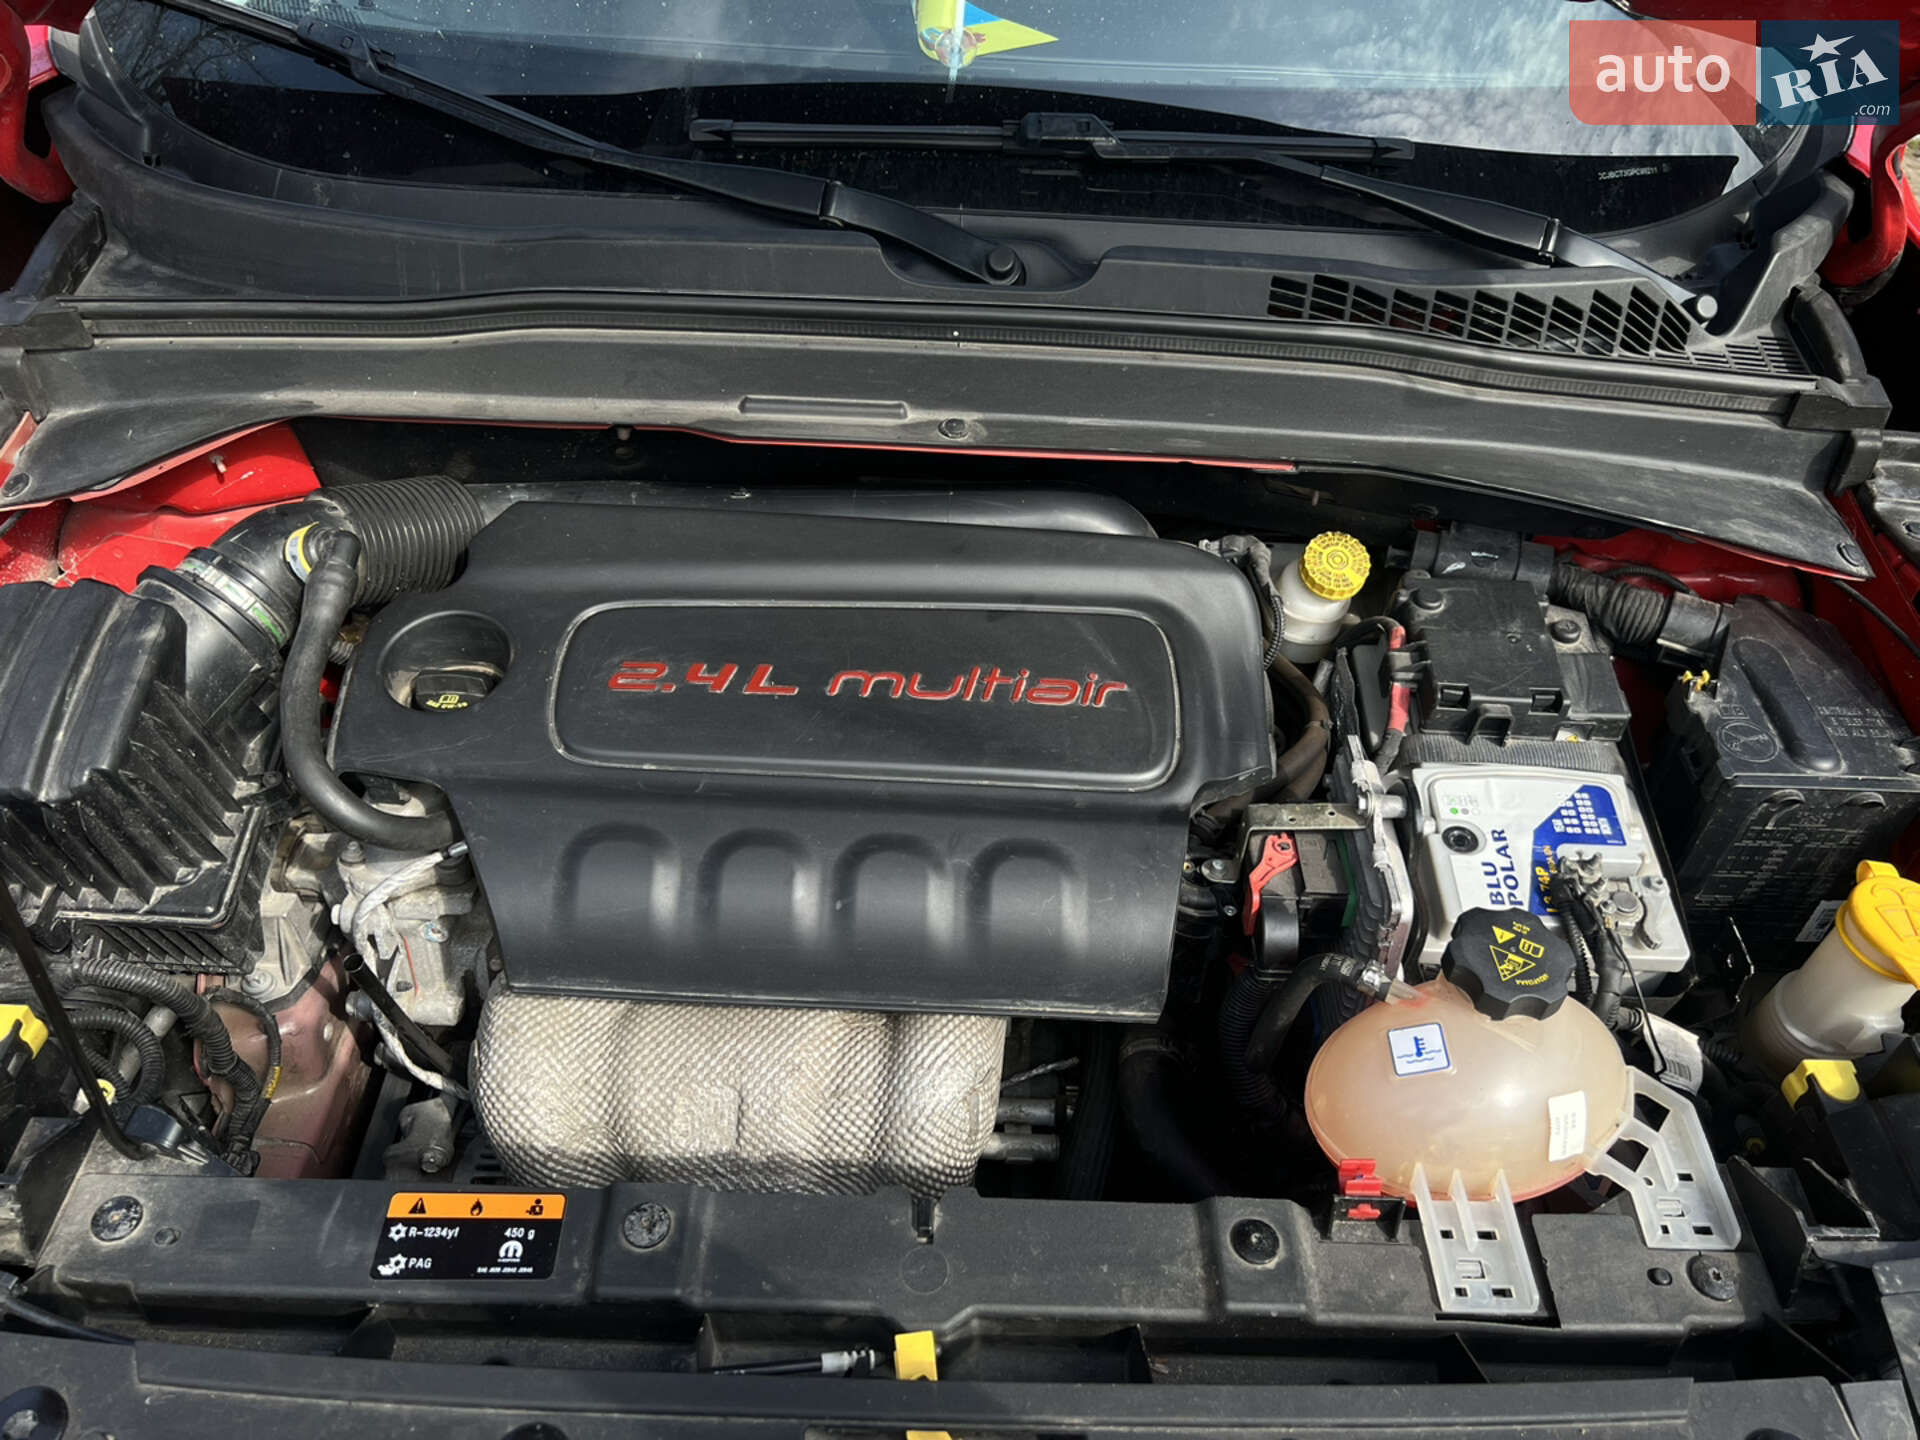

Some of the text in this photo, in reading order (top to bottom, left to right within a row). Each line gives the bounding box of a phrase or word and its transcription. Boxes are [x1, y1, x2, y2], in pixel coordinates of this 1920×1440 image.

[828, 665, 1128, 707] multiair
[1492, 830, 1523, 906] POLAR
[1482, 862, 1505, 905] BLU
[408, 1226, 460, 1240] R-1234yf
[504, 1227, 536, 1240] 450 g
[408, 1257, 433, 1269] PAG
